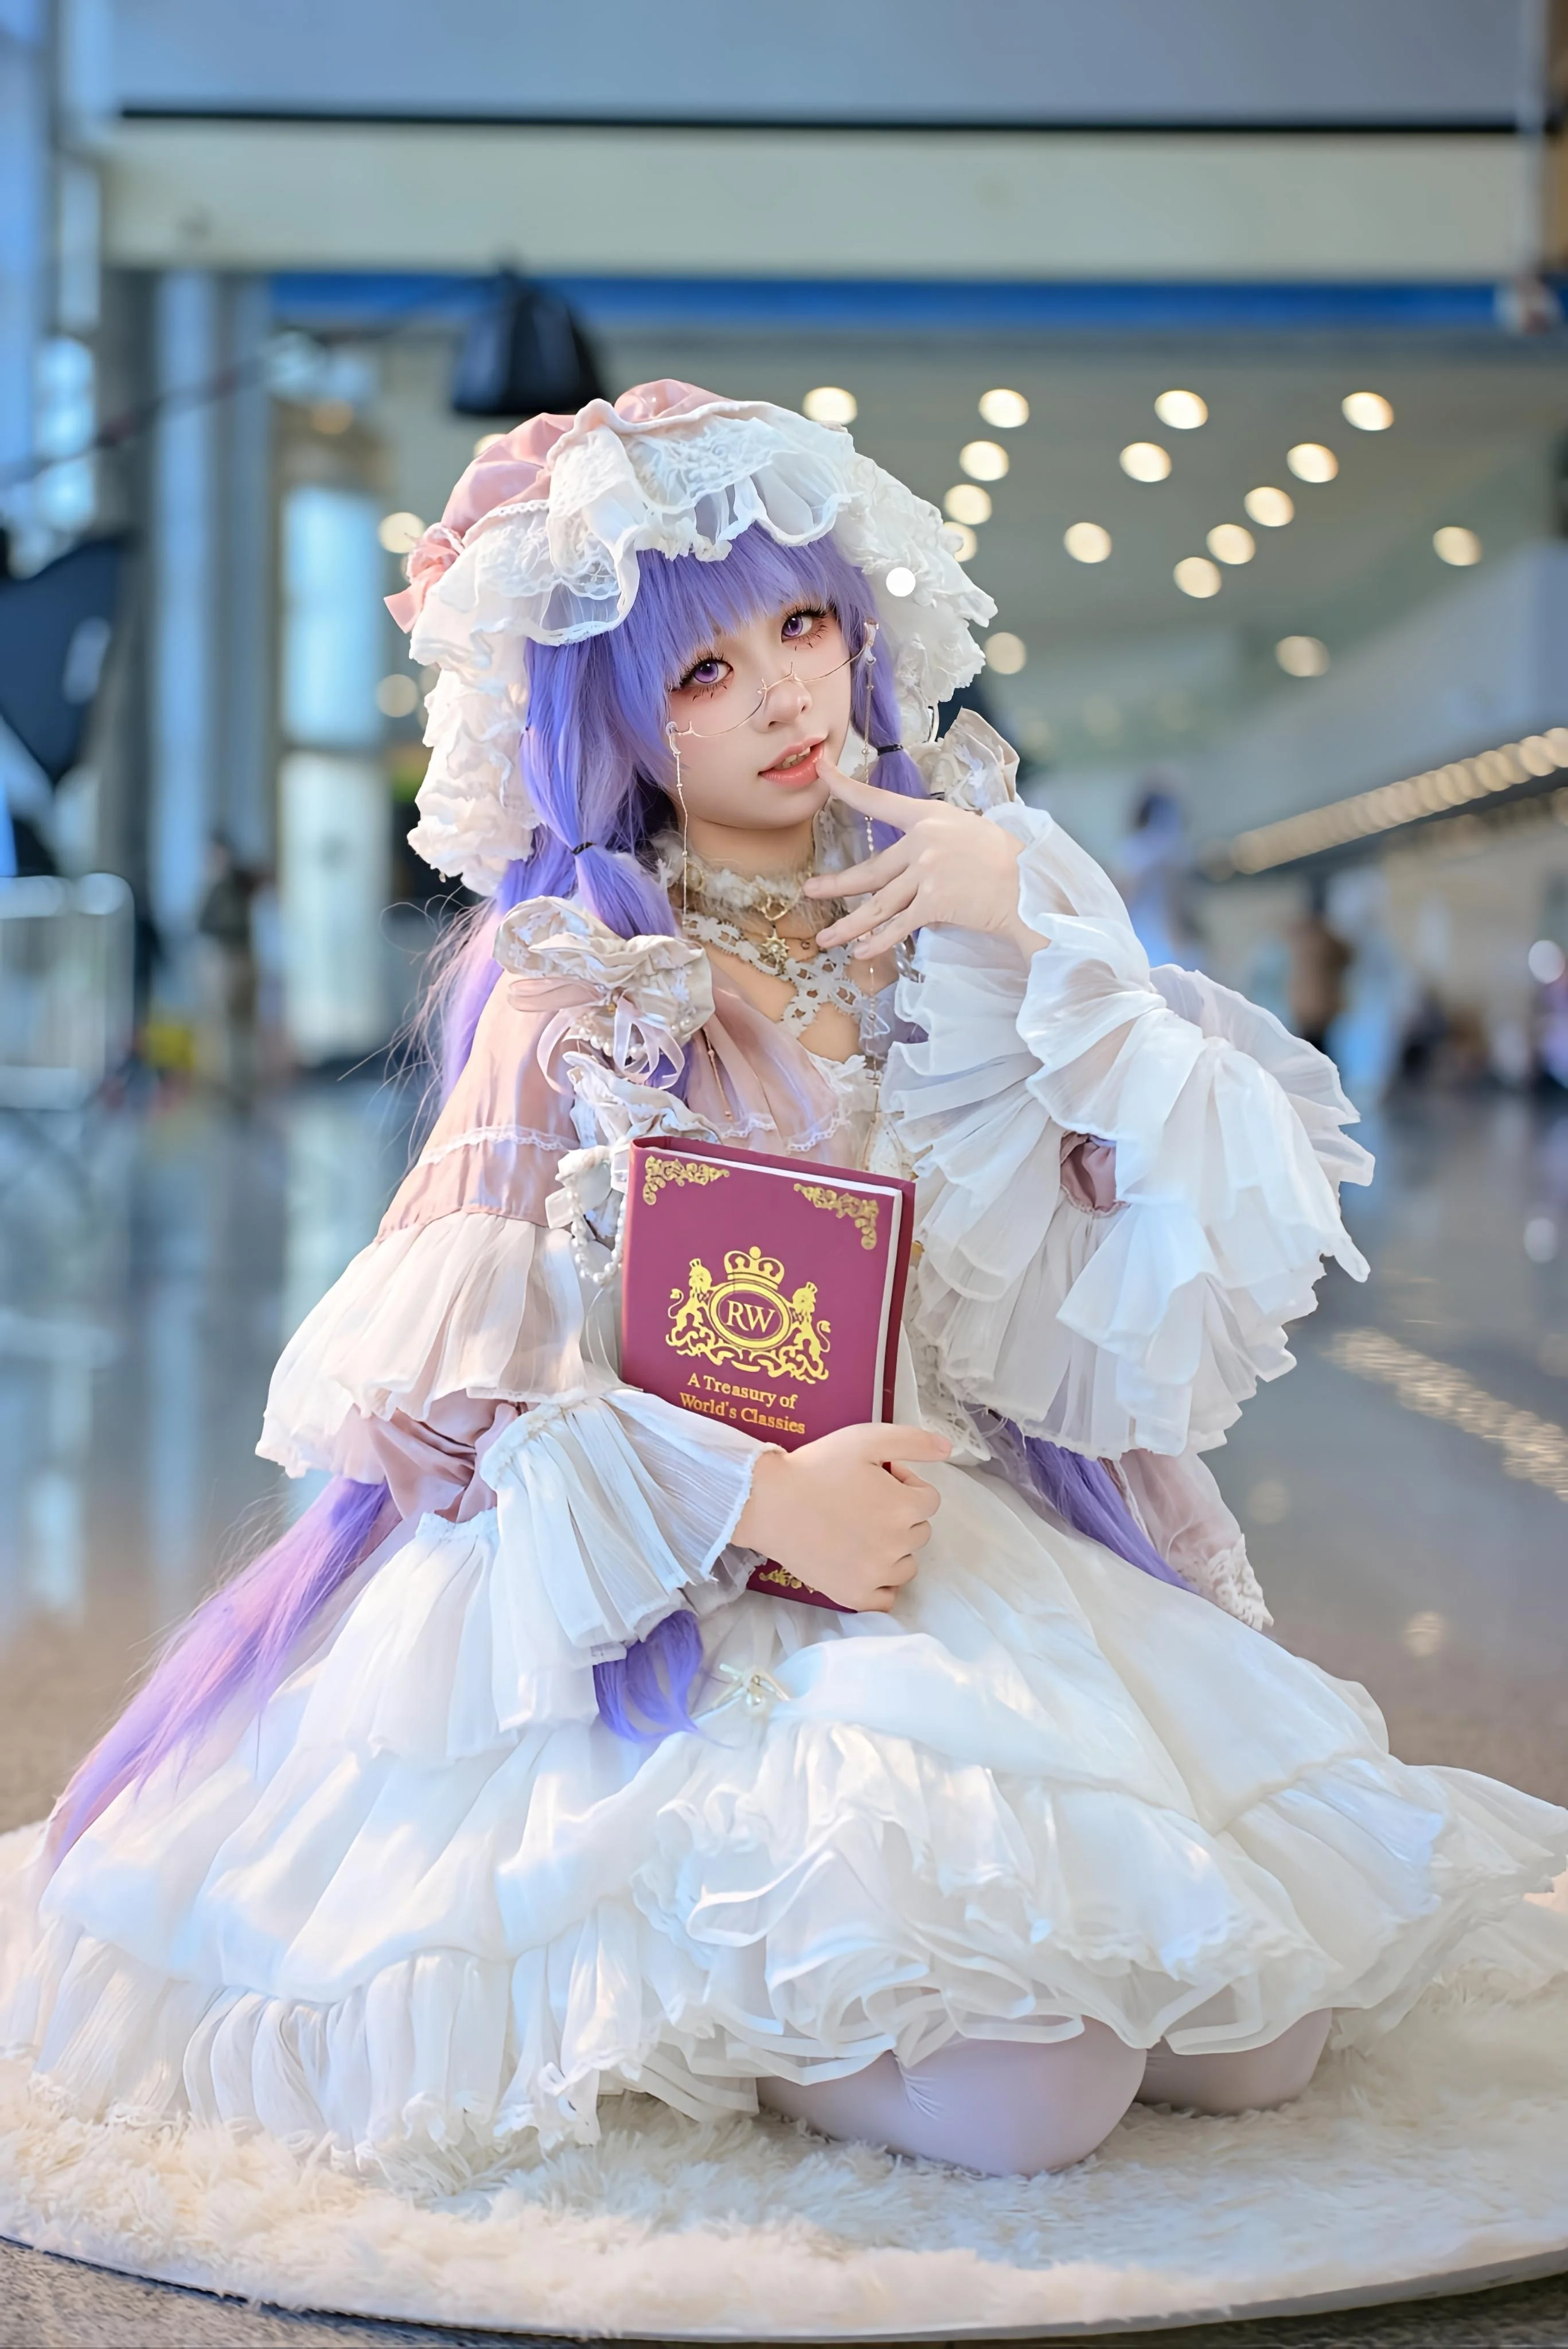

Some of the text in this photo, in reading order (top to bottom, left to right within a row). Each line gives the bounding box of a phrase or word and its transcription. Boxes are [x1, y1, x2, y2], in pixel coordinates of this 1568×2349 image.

[726, 1300, 775, 1333] RW
[687, 1373, 798, 1409] A Treasury of
[679, 1392, 805, 1434] World's Classics
